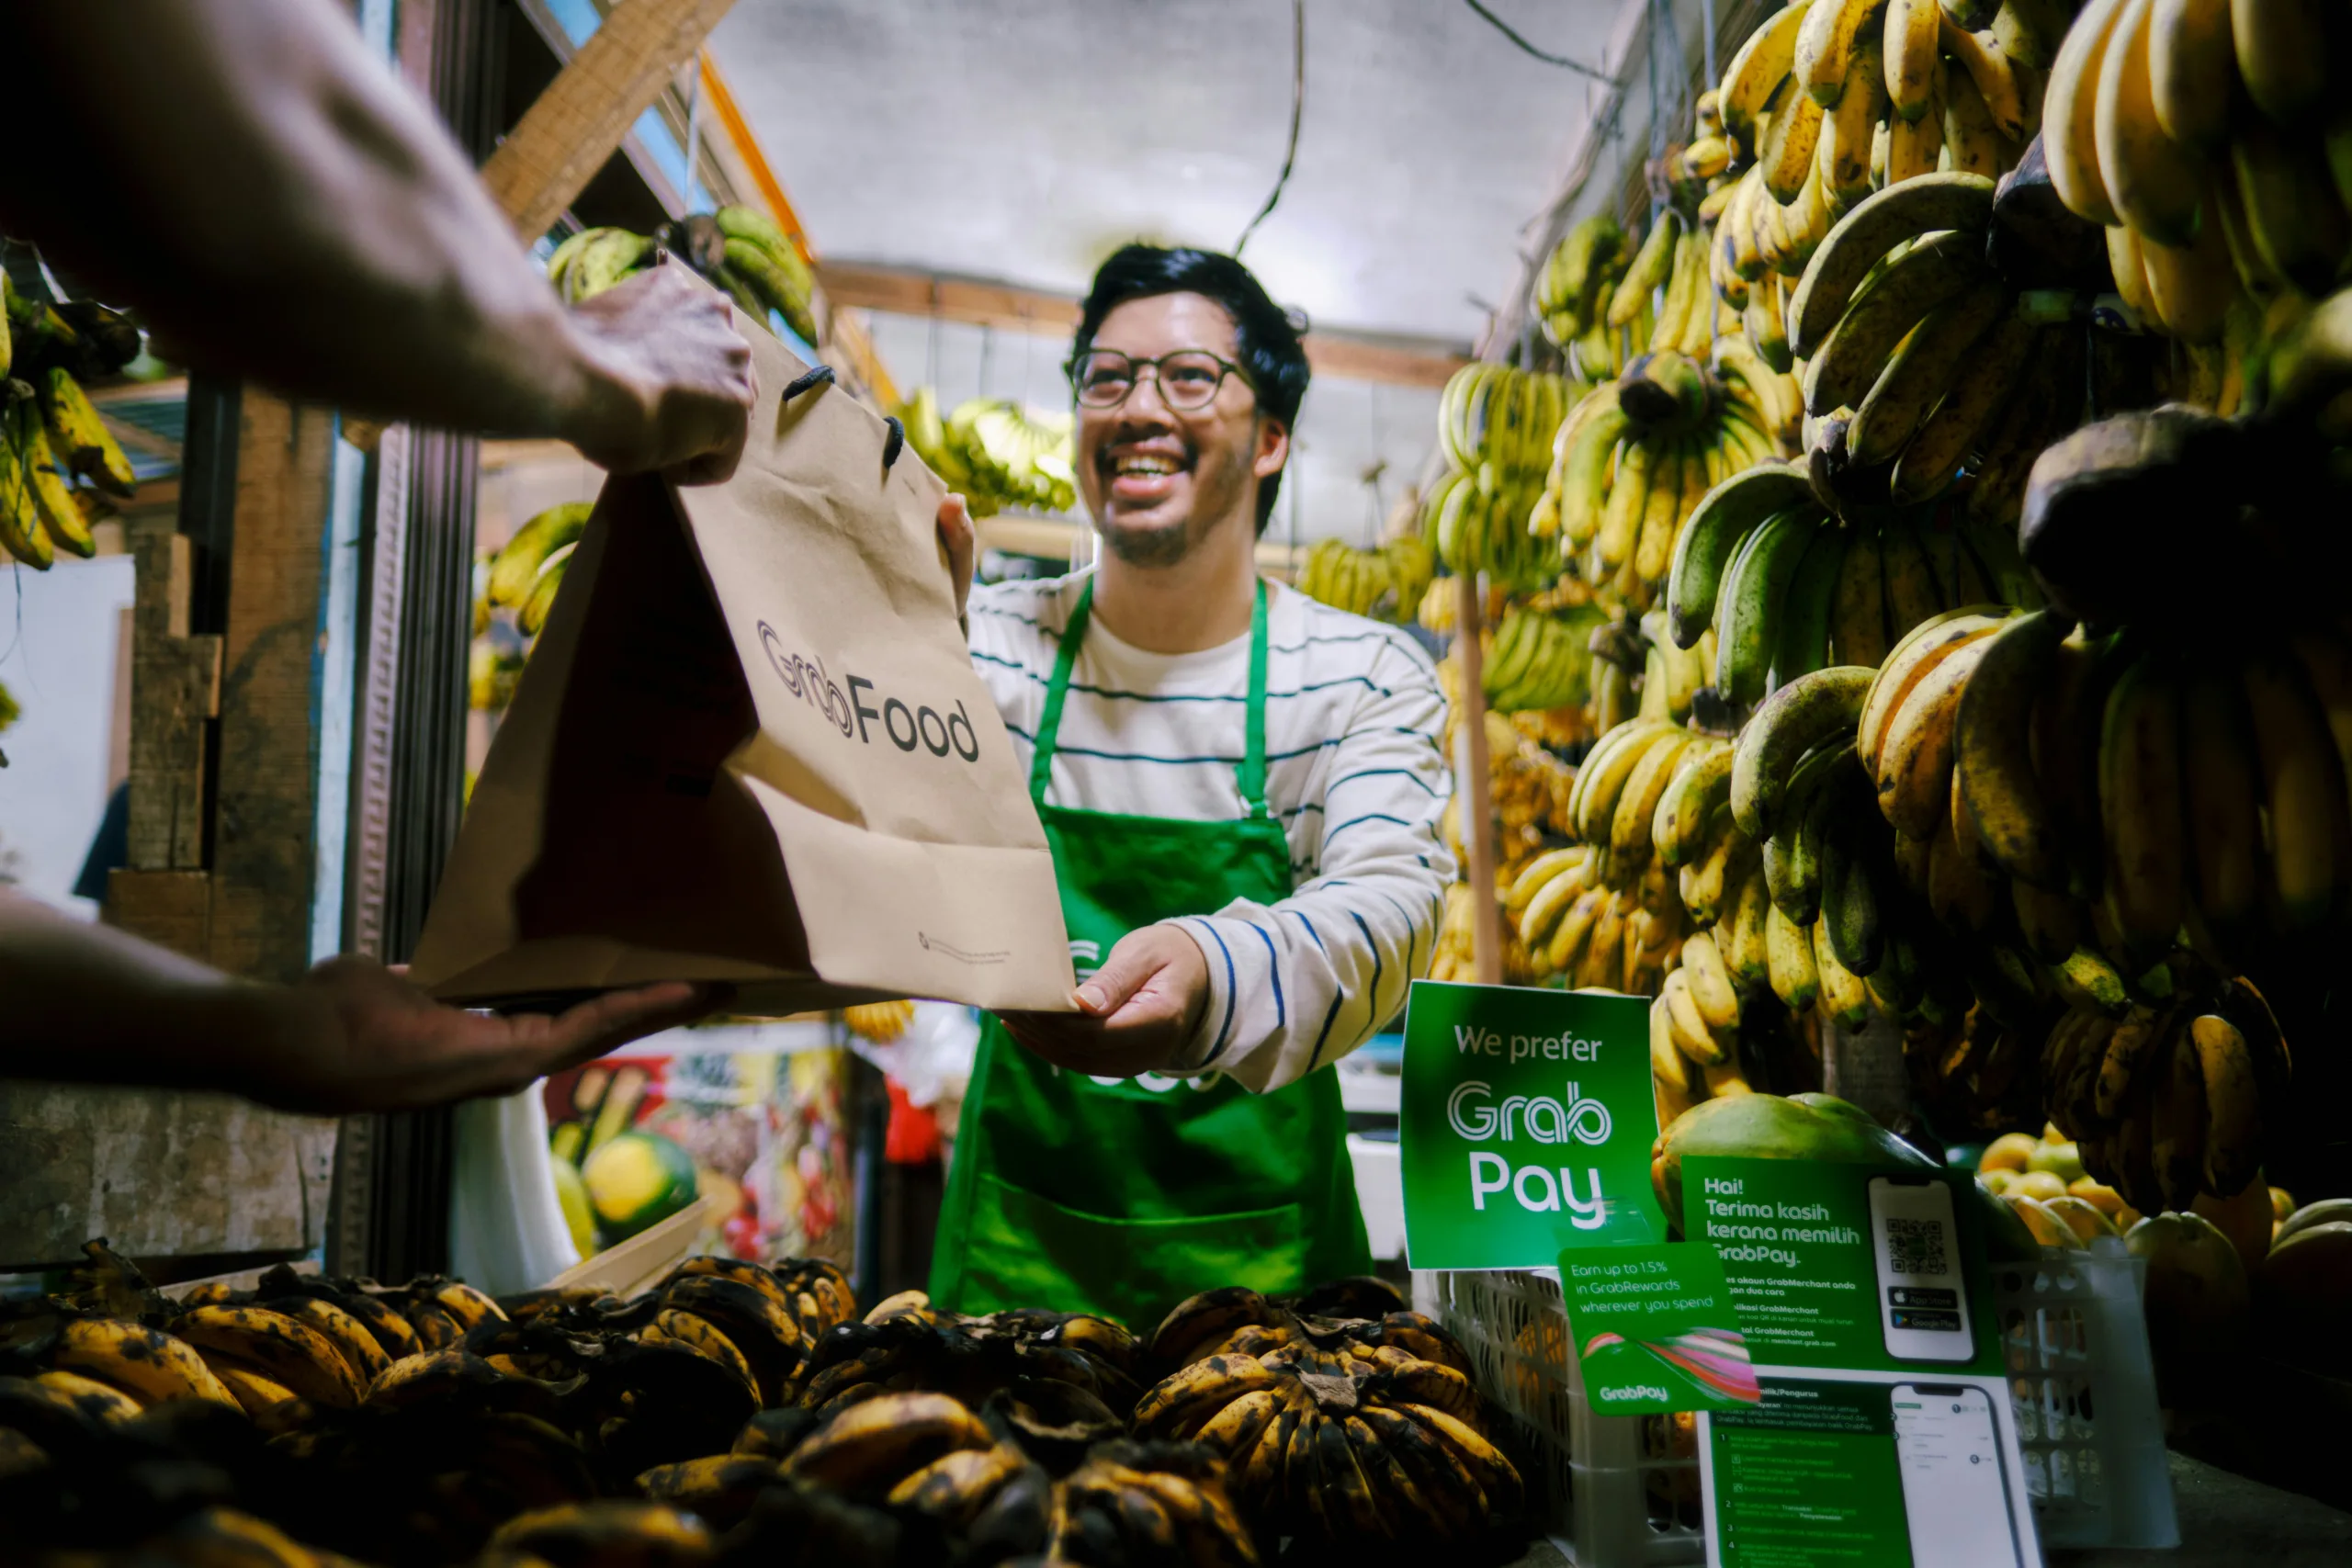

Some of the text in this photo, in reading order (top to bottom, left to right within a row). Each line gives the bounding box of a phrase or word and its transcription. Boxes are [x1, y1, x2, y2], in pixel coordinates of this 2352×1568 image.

[1454, 1024, 1602, 1064] We prefer
[1447, 1081, 1611, 1145] Grab
[1469, 1152, 1607, 1230] Pay
[1704, 1178, 1744, 1195] Hai!
[1705, 1200, 1829, 1221] Terima kasih
[1706, 1220, 1860, 1245] kerana memilih
[1571, 1261, 1668, 1278] Earn up to 1.5%
[1576, 1280, 1680, 1295] in GrabRewards
[1737, 1277, 1765, 1285] akaun
[1767, 1278, 1831, 1289] GrabMerchant
[1833, 1281, 1856, 1290] anda
[1747, 1287, 1763, 1295] dua
[1765, 1289, 1785, 1297] cara
[1909, 1295, 1952, 1305] App Store
[1580, 1295, 1714, 1314] wherever you spend
[1759, 1304, 1819, 1314] GrabMerchant
[1911, 1317, 1939, 1328] Google
[1754, 1327, 1815, 1337] GrabMerchant
[1600, 1385, 1668, 1402] GrabPay
[1727, 1524, 1734, 1532] 3
[1728, 1540, 1735, 1549] 4
